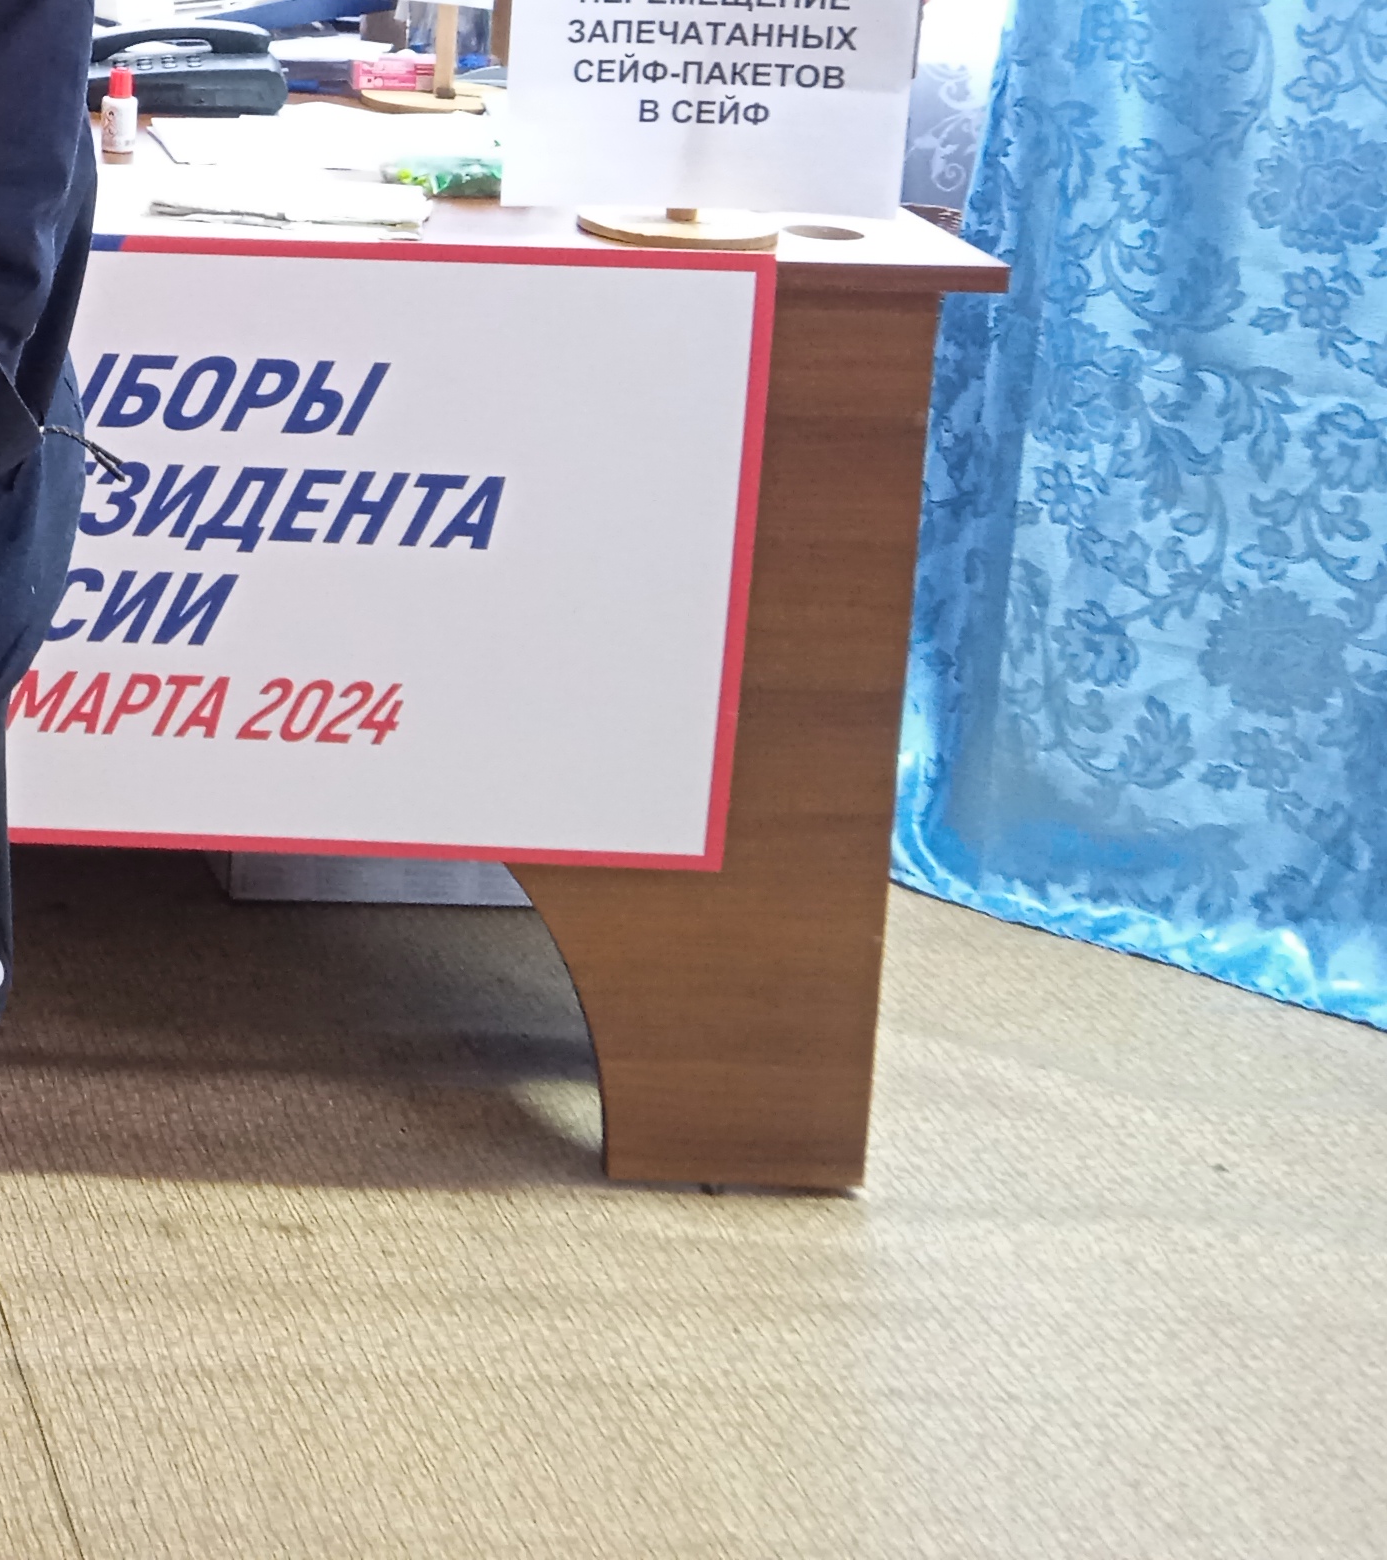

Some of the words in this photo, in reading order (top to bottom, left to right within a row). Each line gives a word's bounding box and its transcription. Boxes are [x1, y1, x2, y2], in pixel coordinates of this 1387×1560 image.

[567, 19, 858, 52] ЗАПЕЧАТАННЫХ
[573, 53, 846, 90] СЕЙФ-ПАКЕТОВ
[638, 98, 659, 123] В
[671, 95, 770, 126] СЕЙФ
[78, 461, 506, 553] ЗИДЕНТА
[5, 669, 231, 739] МАРТА
[235, 677, 404, 746] 2024
